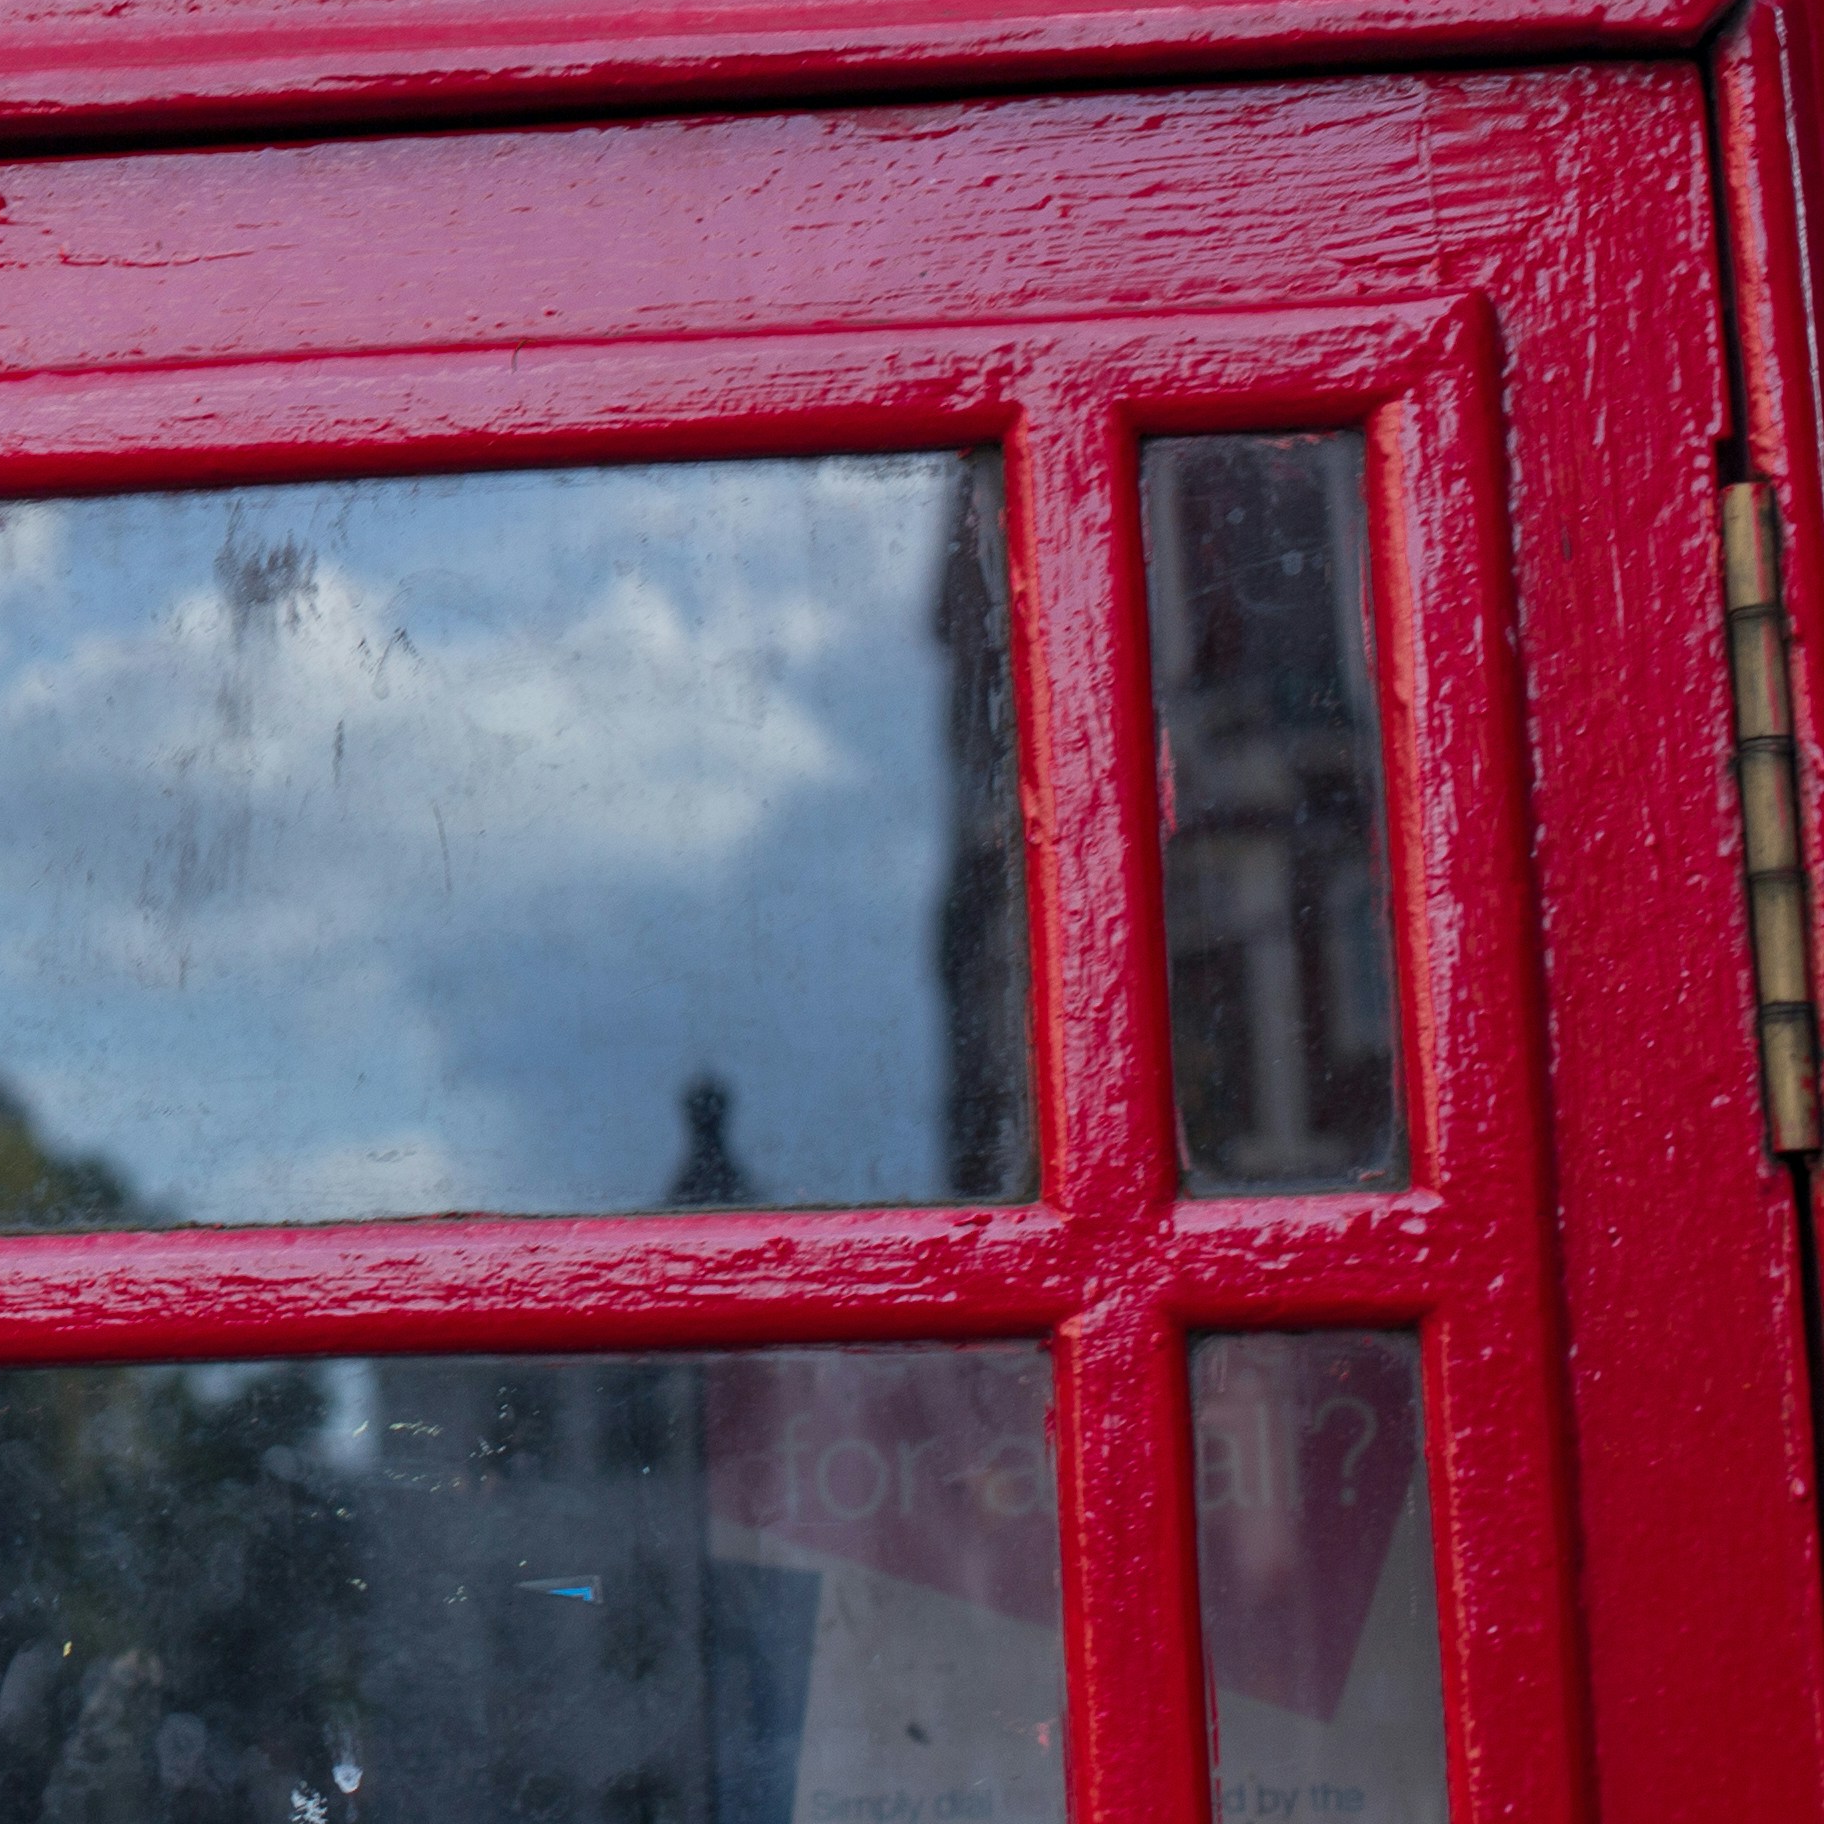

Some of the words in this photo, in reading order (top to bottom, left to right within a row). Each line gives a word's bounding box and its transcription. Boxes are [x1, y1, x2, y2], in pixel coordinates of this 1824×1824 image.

[776, 1410, 936, 1523] for
[1198, 1397, 1378, 1510] all?
[1257, 1783, 1301, 1818] by
[1311, 1781, 1366, 1814] the
